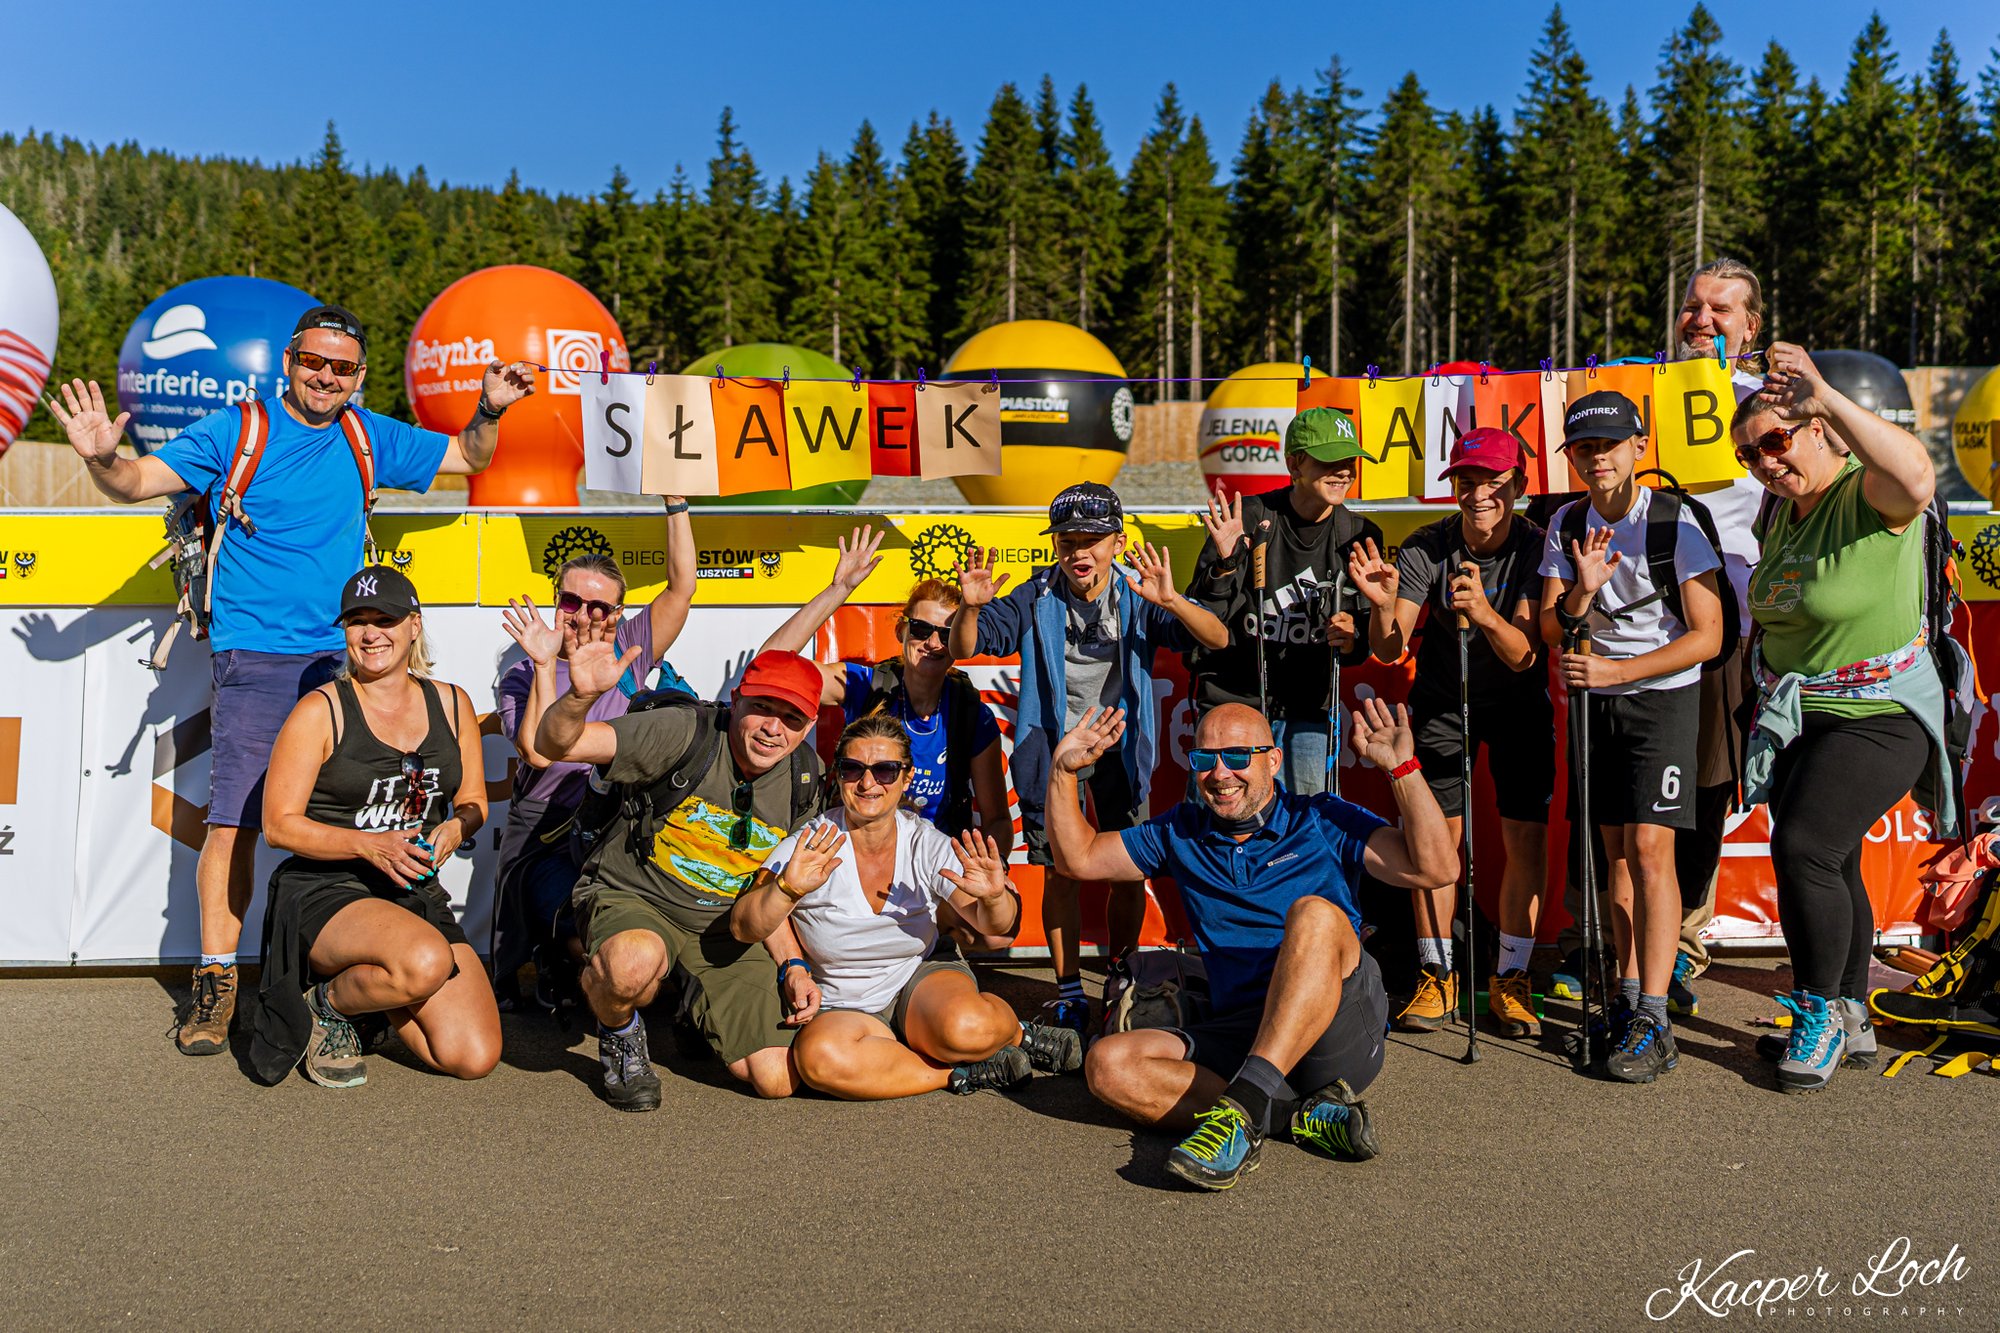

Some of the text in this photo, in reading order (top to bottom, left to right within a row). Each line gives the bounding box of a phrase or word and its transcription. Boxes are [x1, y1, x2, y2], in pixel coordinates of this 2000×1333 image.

[1000, 396, 1069, 411] PIASTÓW
[1206, 419, 1280, 437] JELENIA
[1220, 440, 1279, 463] GÓRA
[1661, 765, 1682, 800] 6
